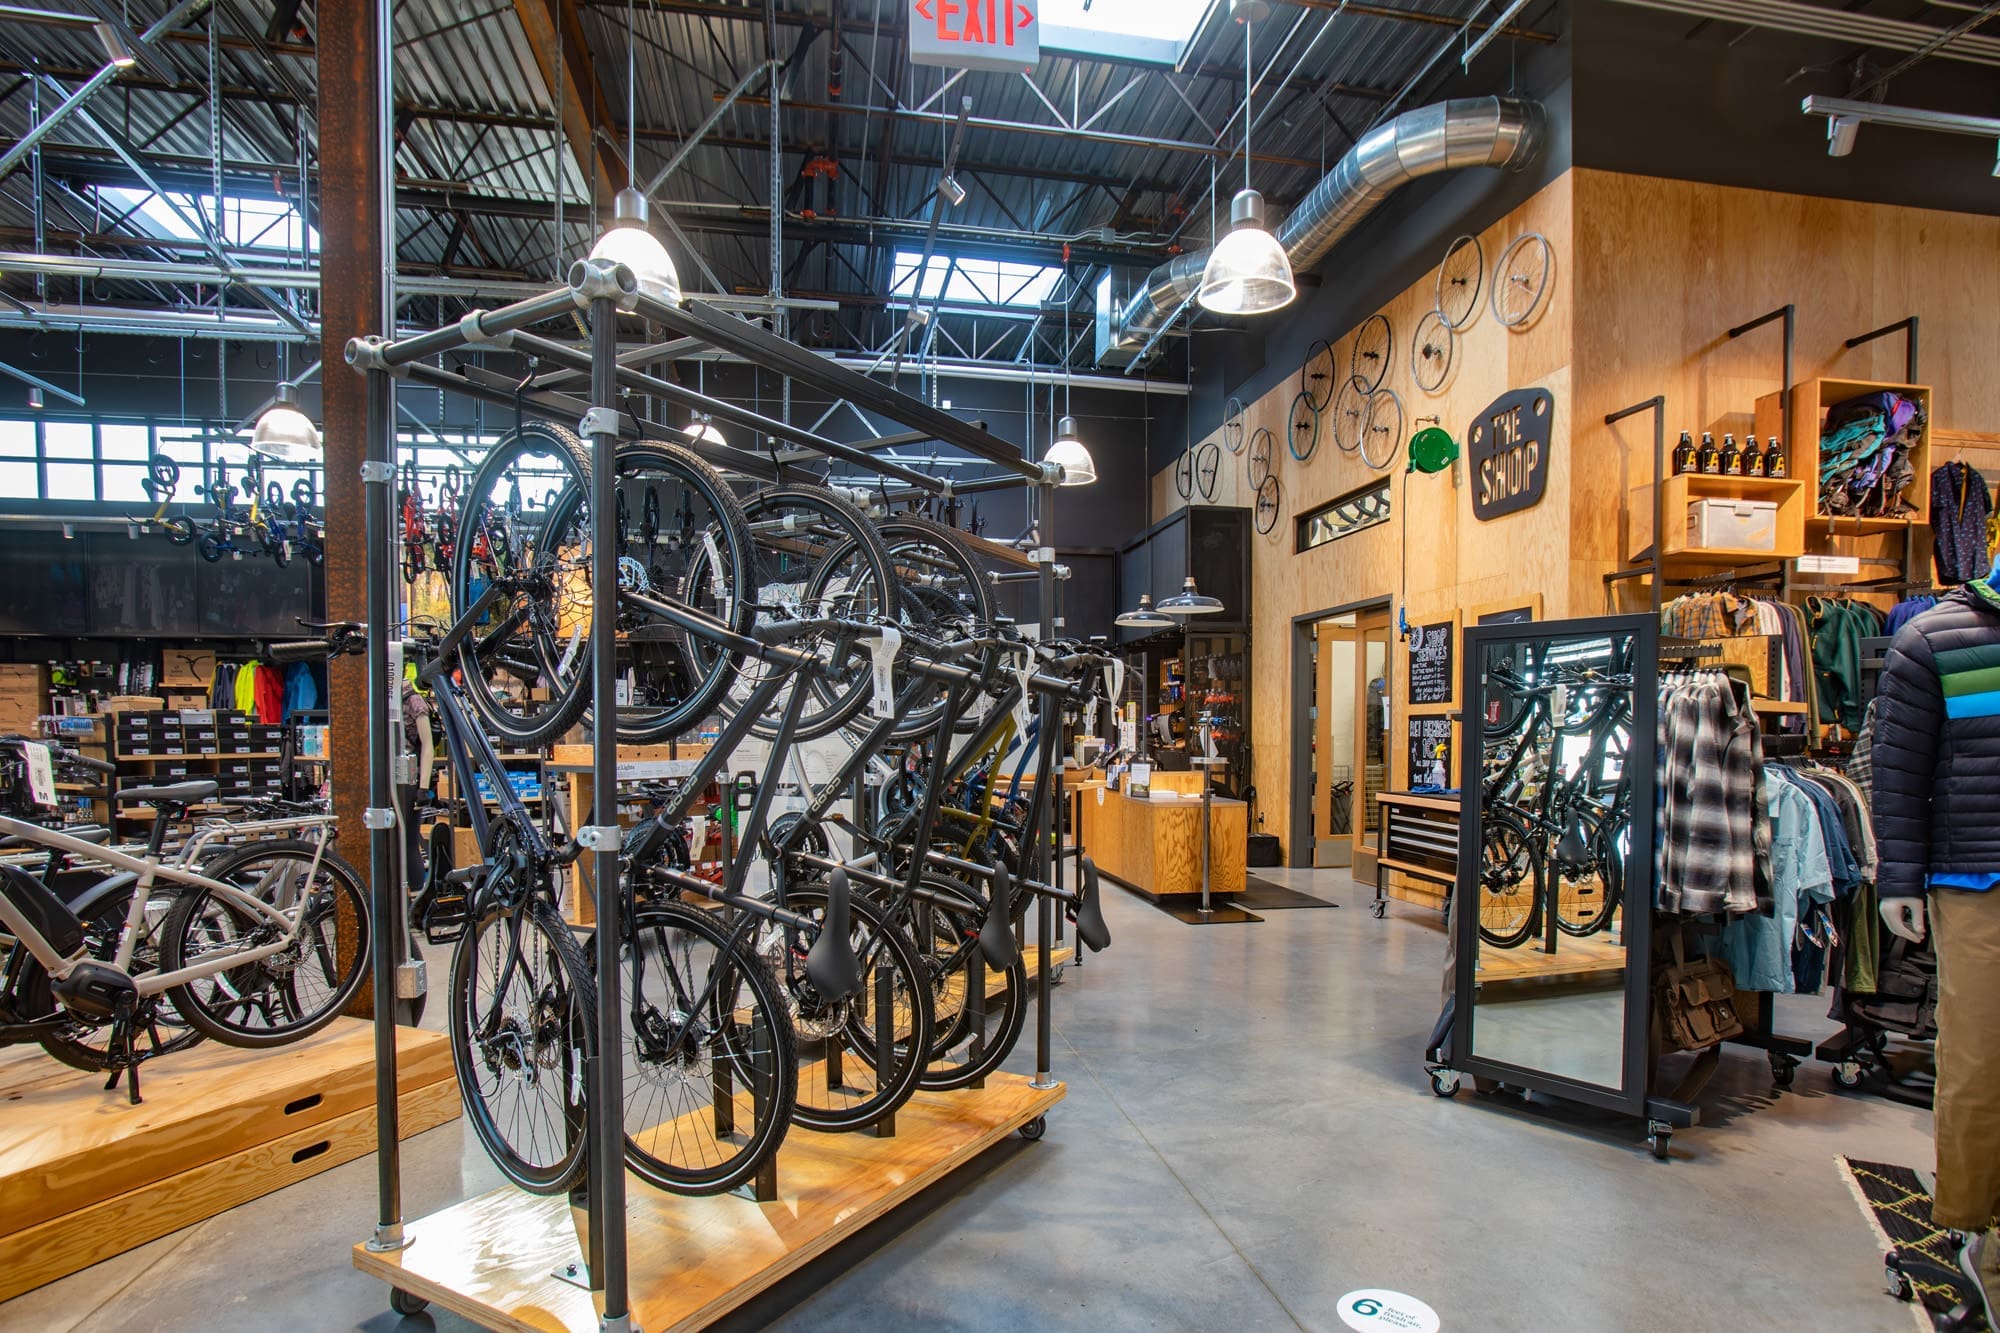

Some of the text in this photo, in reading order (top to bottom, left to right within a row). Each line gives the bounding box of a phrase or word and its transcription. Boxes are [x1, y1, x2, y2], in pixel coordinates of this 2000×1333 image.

[1490, 404, 1522, 450] THE
[1479, 439, 1539, 506] SHOP
[1426, 627, 1448, 648] SHOP
[1416, 645, 1448, 662] SERVICES
[879, 700, 888, 712] M
[38, 791, 49, 801] M
[1352, 1298, 1383, 1317] 6
